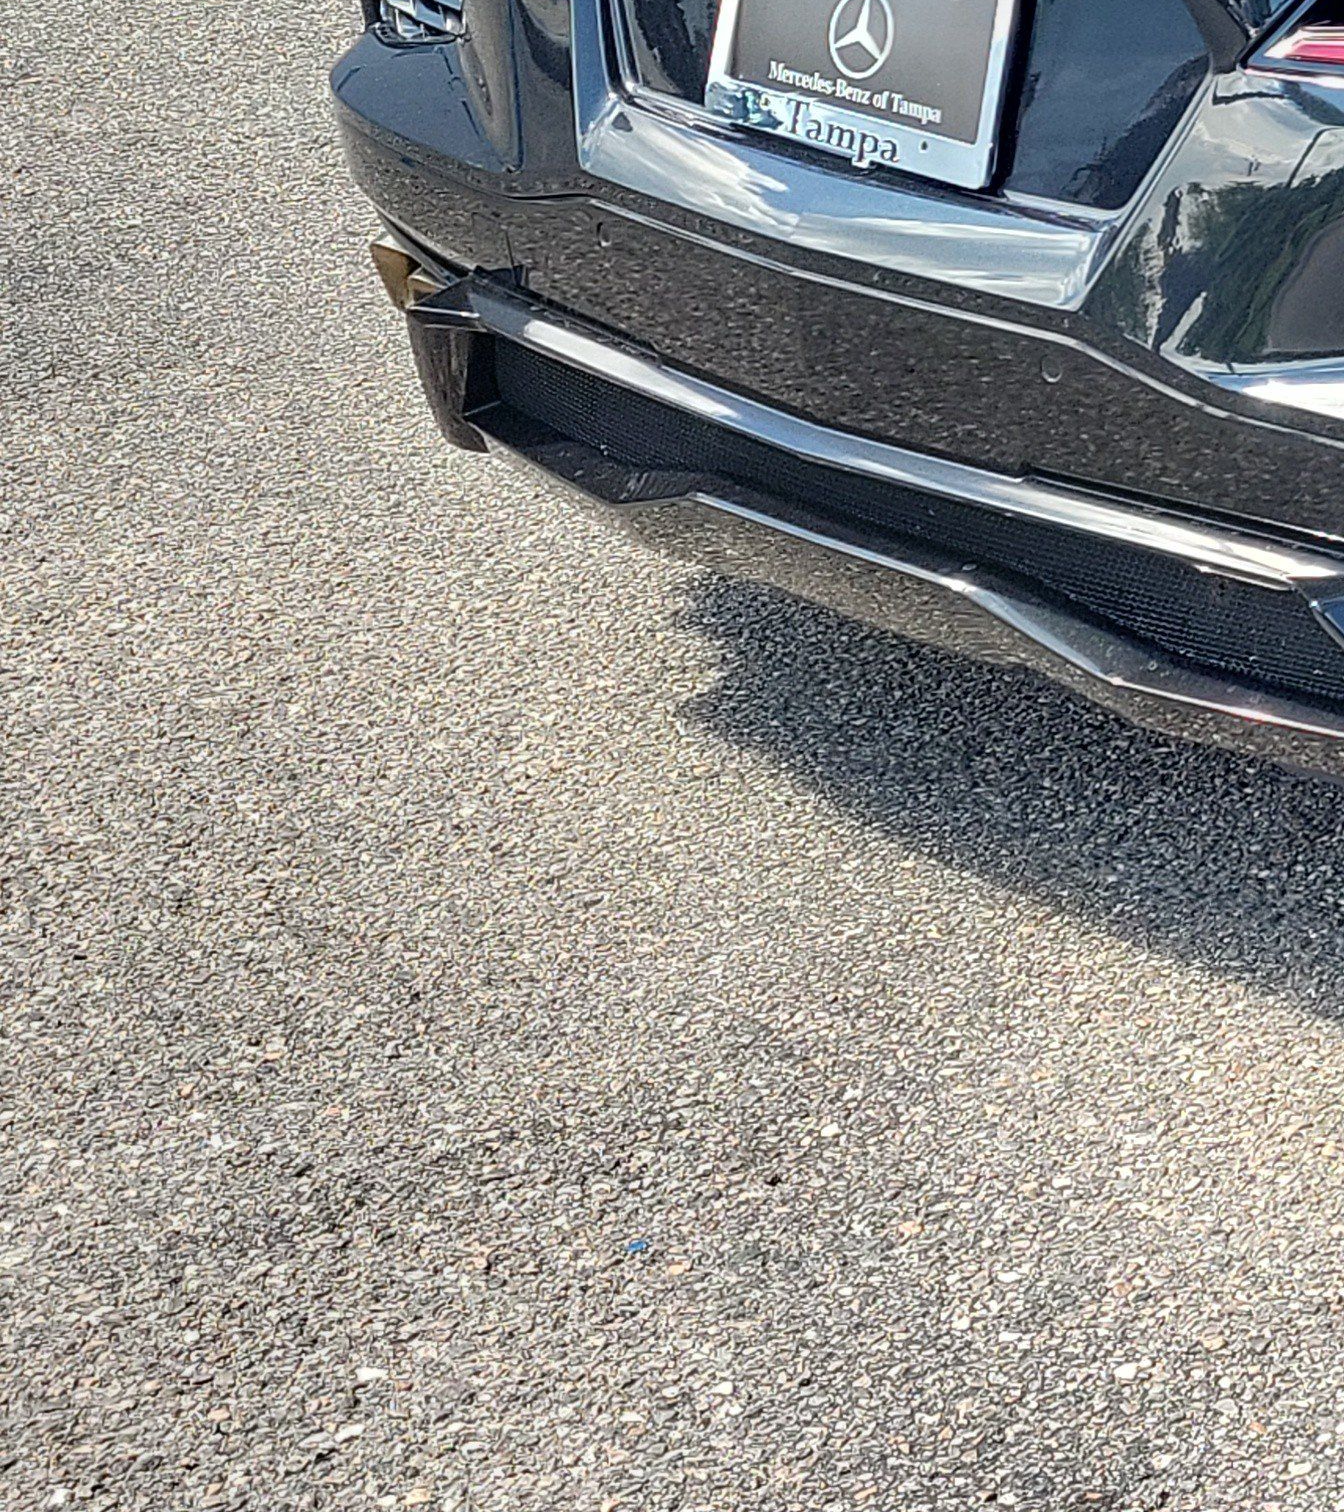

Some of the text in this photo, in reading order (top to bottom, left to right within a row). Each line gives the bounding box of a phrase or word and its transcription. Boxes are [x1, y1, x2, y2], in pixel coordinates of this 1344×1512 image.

[768, 60, 942, 125] Mercedes-Benz of Tampa
[786, 99, 900, 164] Tampa
